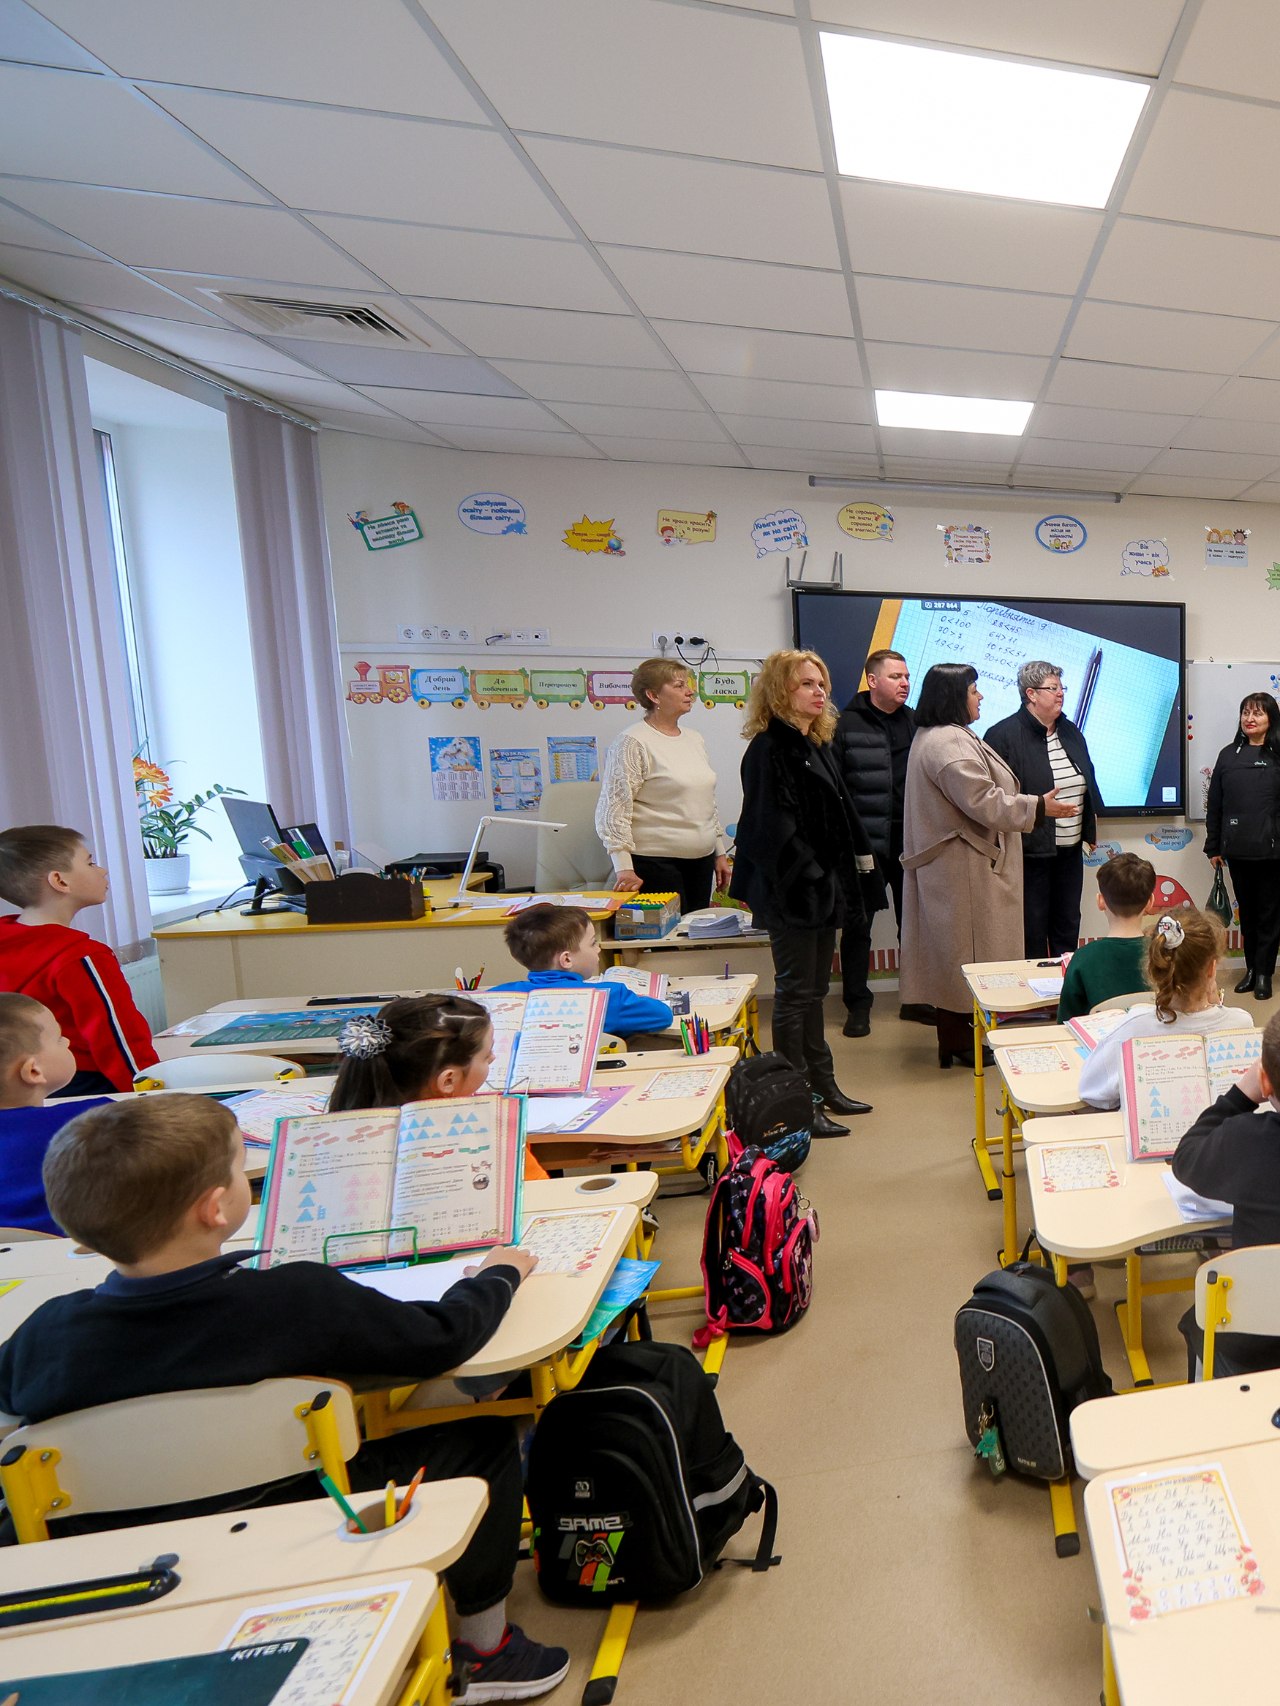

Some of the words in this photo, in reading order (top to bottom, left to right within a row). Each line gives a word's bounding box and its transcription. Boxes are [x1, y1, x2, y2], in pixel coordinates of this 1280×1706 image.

[425, 675, 456, 683] Добрий
[714, 677, 735, 686] Будь
[432, 683, 451, 691] день
[230, 1643, 280, 1663] KITE
